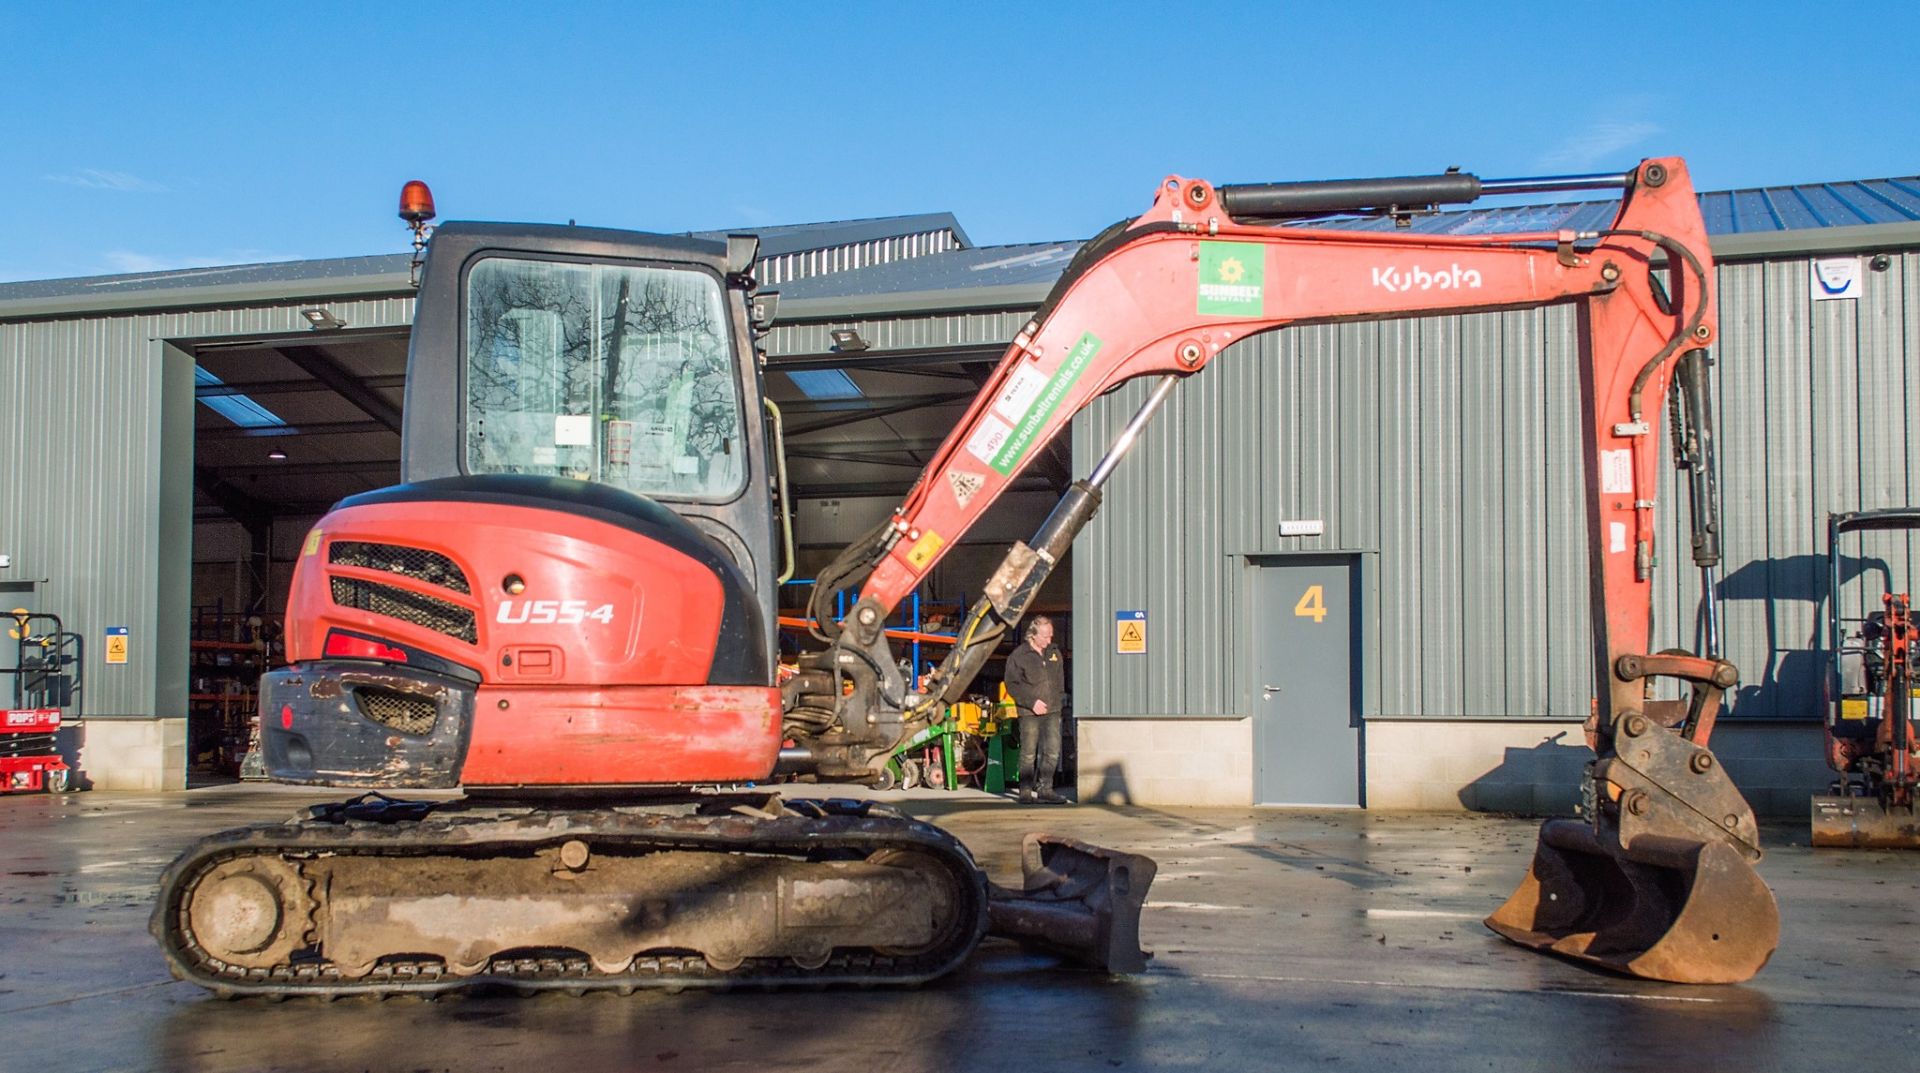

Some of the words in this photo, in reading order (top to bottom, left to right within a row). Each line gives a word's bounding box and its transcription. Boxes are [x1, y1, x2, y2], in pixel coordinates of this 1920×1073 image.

[1372, 263, 1482, 292] Kubota
[998, 341, 1097, 468] www.sunbeltrentals.co.uk
[1294, 584, 1327, 623] 4
